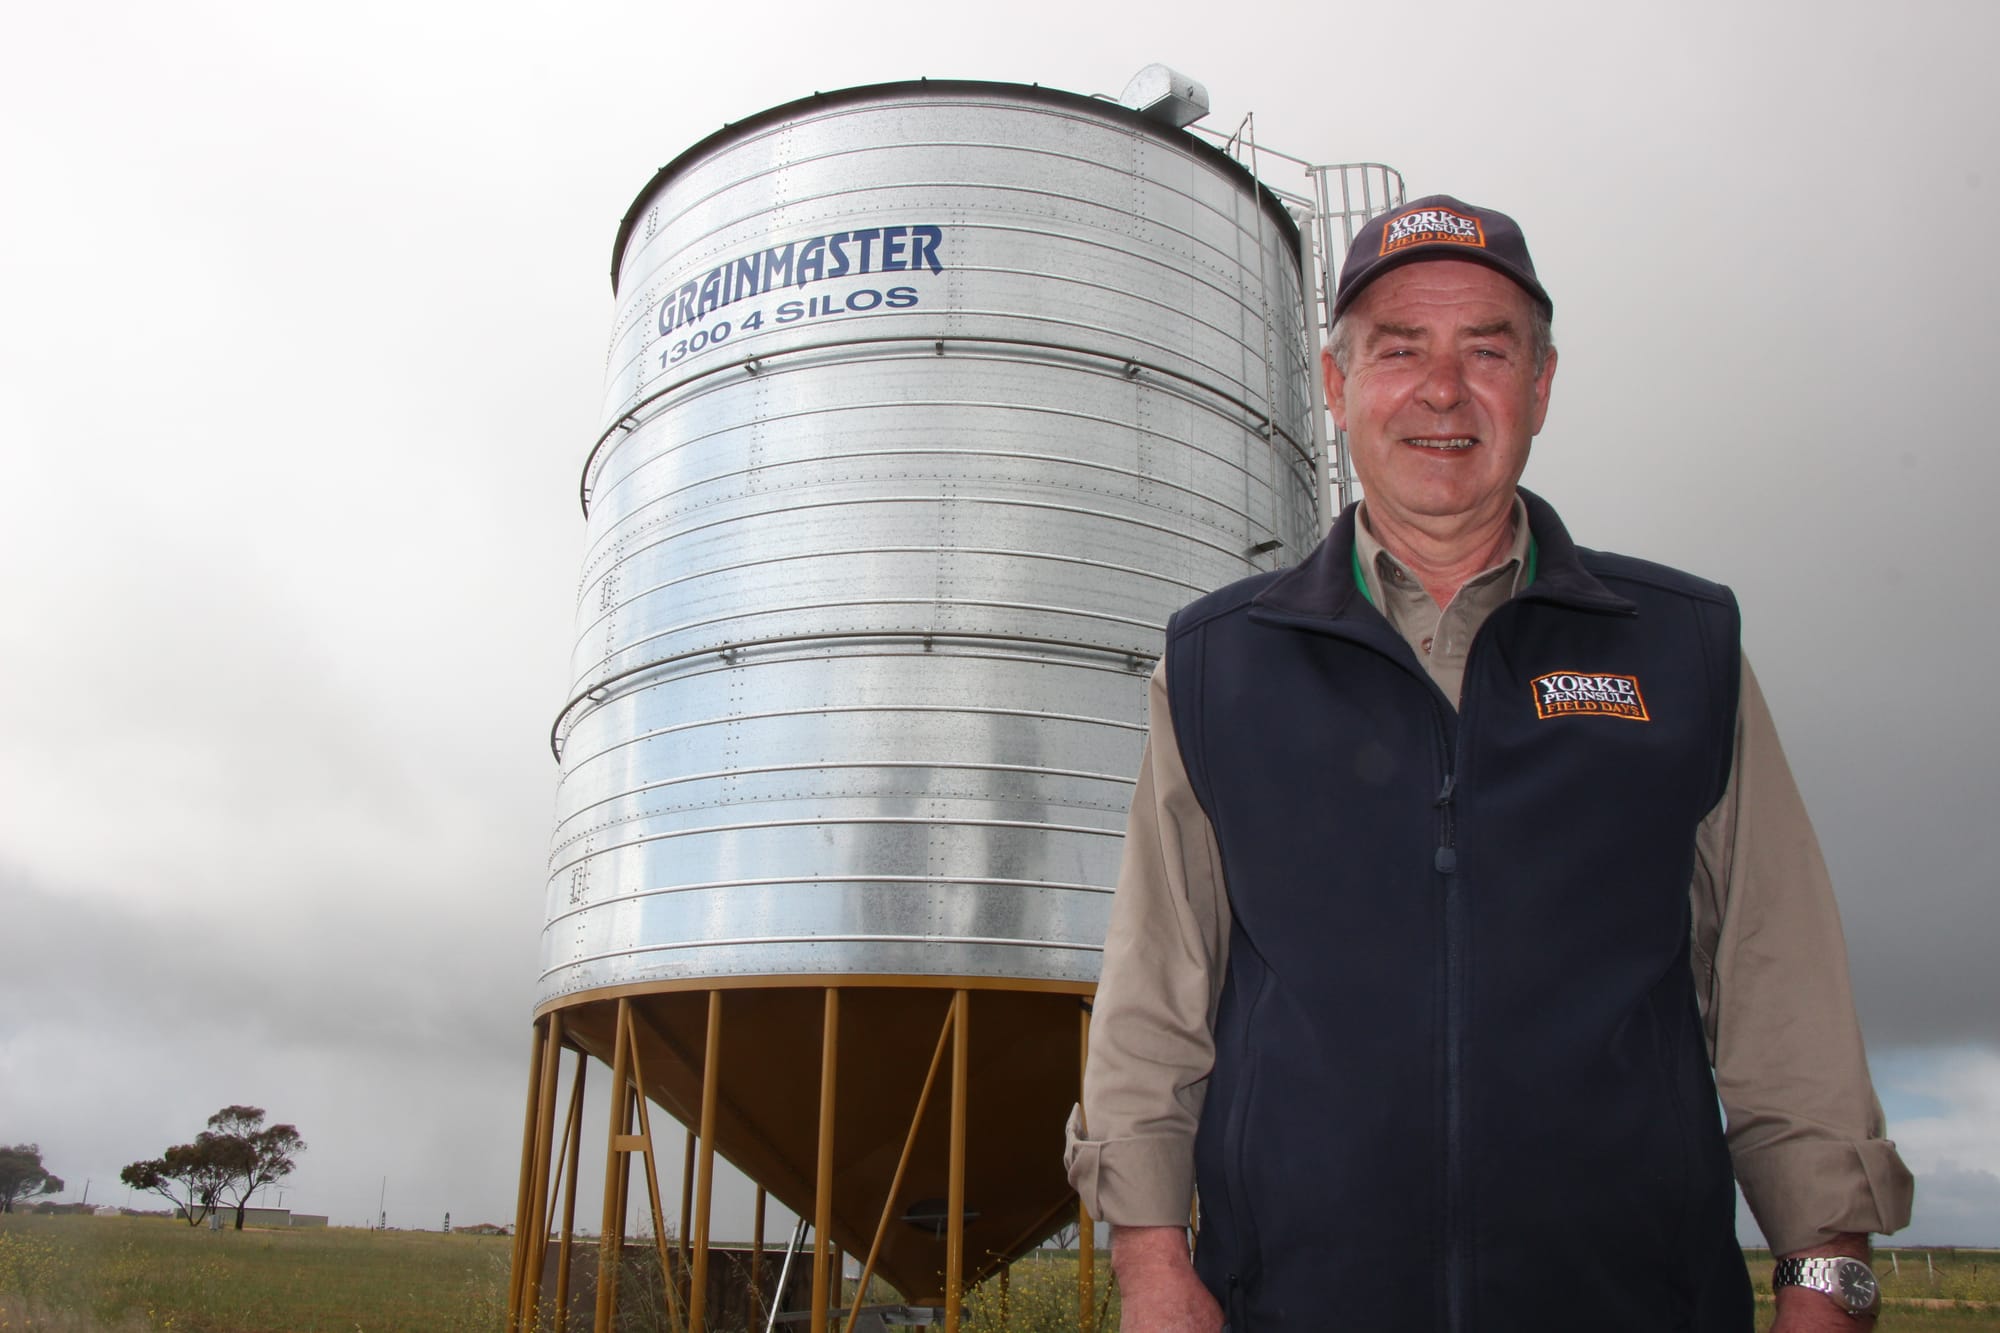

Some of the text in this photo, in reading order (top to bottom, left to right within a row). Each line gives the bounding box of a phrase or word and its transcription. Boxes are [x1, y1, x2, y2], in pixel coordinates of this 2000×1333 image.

[1391, 211, 1475, 233] YORKE
[1388, 223, 1475, 243] PENINSULA
[1388, 232, 1476, 250] FIELD DAYS
[658, 225, 944, 336] GRAINMASTER
[659, 286, 918, 368] 1300 4 SILOS
[1540, 675, 1635, 695] YORKE
[1543, 691, 1637, 705] PENINSULA
[1546, 701, 1640, 716] FIELD DAYS
